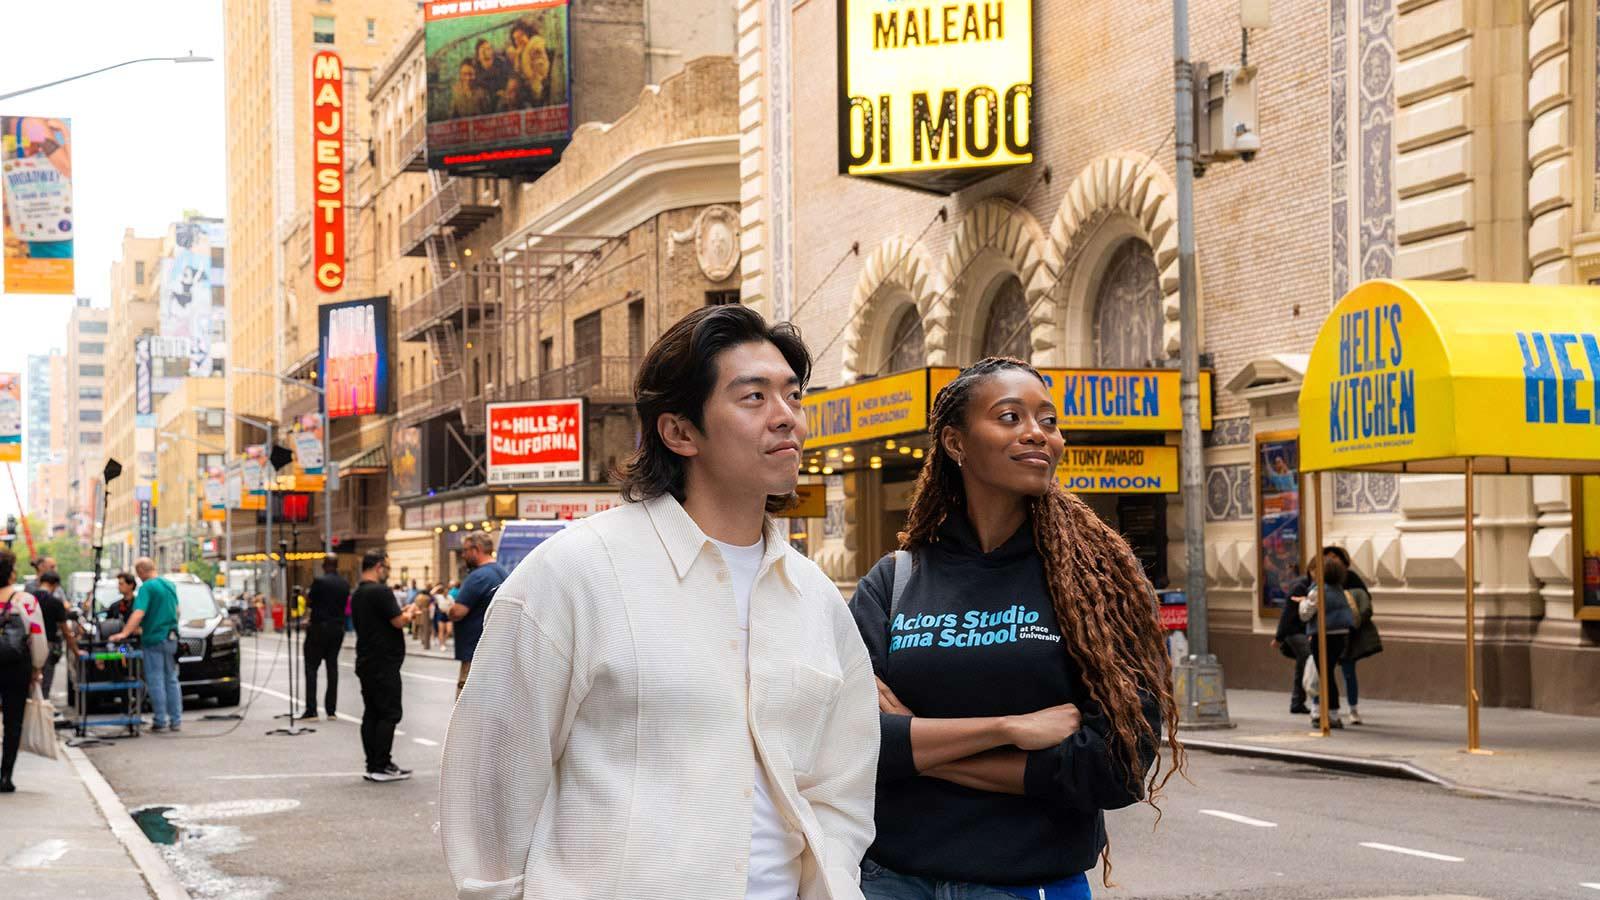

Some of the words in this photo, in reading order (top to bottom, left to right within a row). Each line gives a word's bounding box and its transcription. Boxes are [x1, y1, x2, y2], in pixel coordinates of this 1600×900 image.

[873, 3, 1004, 49] MALEAH
[314, 55, 342, 288] MAJESTIC
[1339, 303, 1402, 376] HELL'S
[863, 397, 879, 410] NEW
[880, 389, 913, 406] MUSICAL
[1064, 375, 1159, 416] KITCHEN
[1330, 368, 1415, 443] KITCHEN
[512, 415, 558, 434] HILLS
[858, 416, 868, 427] ON
[870, 408, 910, 425] BROADWAY
[492, 432, 577, 456] CALIFORNIA
[1072, 449, 1102, 466] TONY
[1104, 449, 1144, 466] AWARD
[1064, 477, 1095, 489] JOI
[1100, 476, 1161, 488] MOON
[890, 612, 958, 632] Actors
[962, 605, 1039, 629] Studio
[1030, 625, 1048, 633] Pace
[889, 632, 933, 653] ama
[938, 624, 1017, 647] School
[1020, 632, 1061, 643] University
